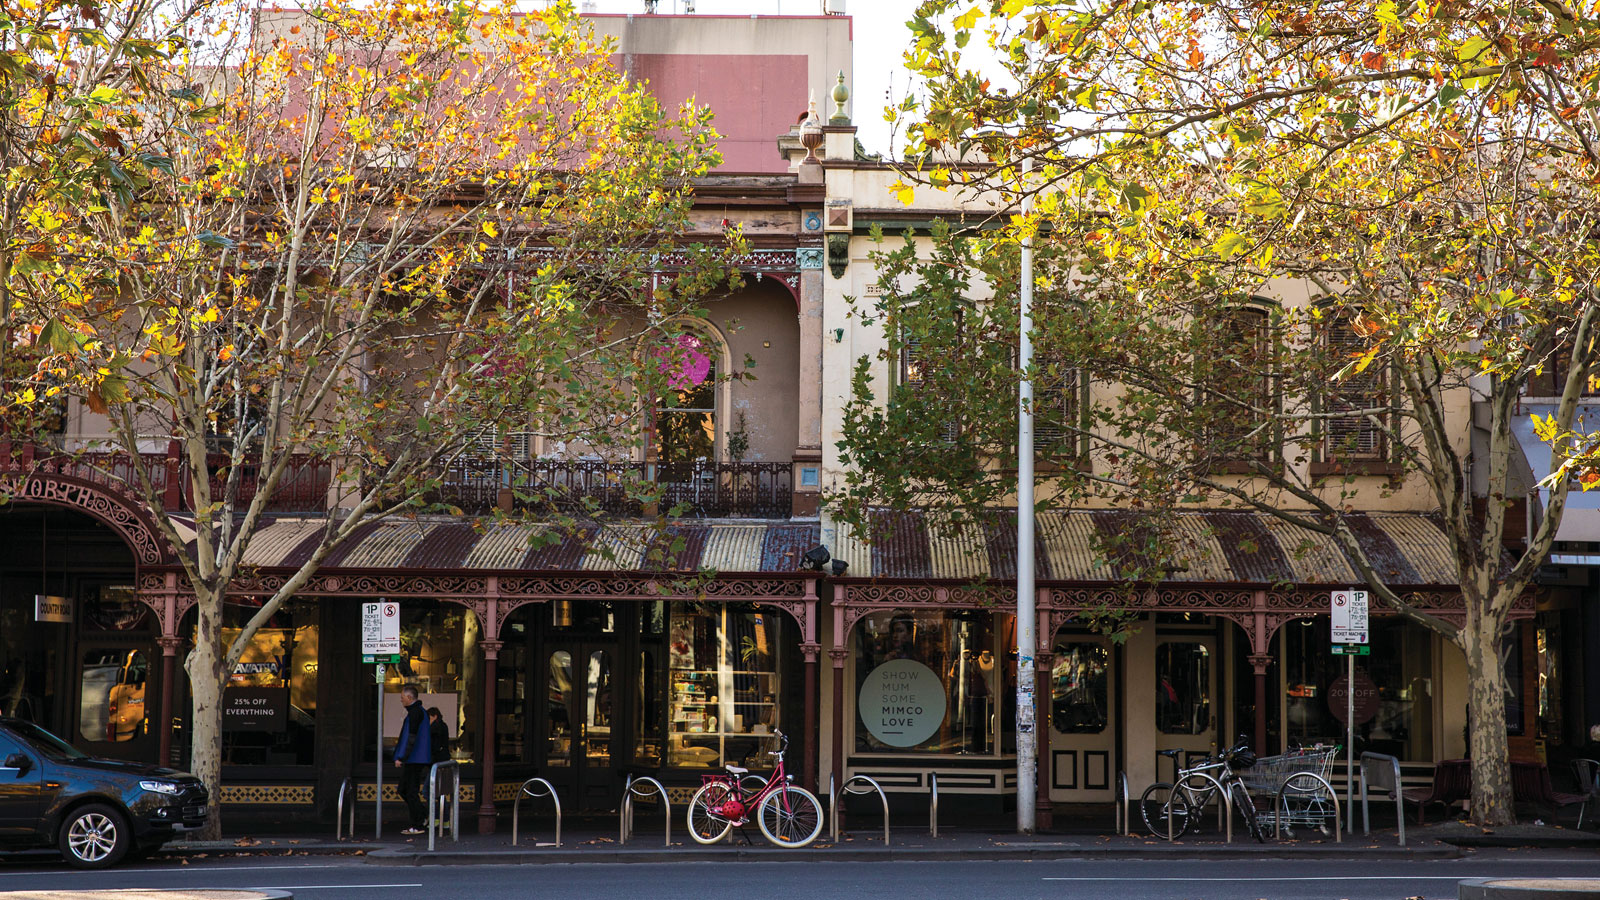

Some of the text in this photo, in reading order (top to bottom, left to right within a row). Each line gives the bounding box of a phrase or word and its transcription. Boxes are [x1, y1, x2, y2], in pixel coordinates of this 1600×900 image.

[1353, 592, 1365, 601] 1P
[366, 604, 377, 614] 1P
[882, 671, 919, 680] SHOW
[882, 683, 910, 692] MUM
[882, 694, 916, 703] SOME
[882, 706, 923, 715] MIMCO
[882, 718, 914, 727] LOVE
